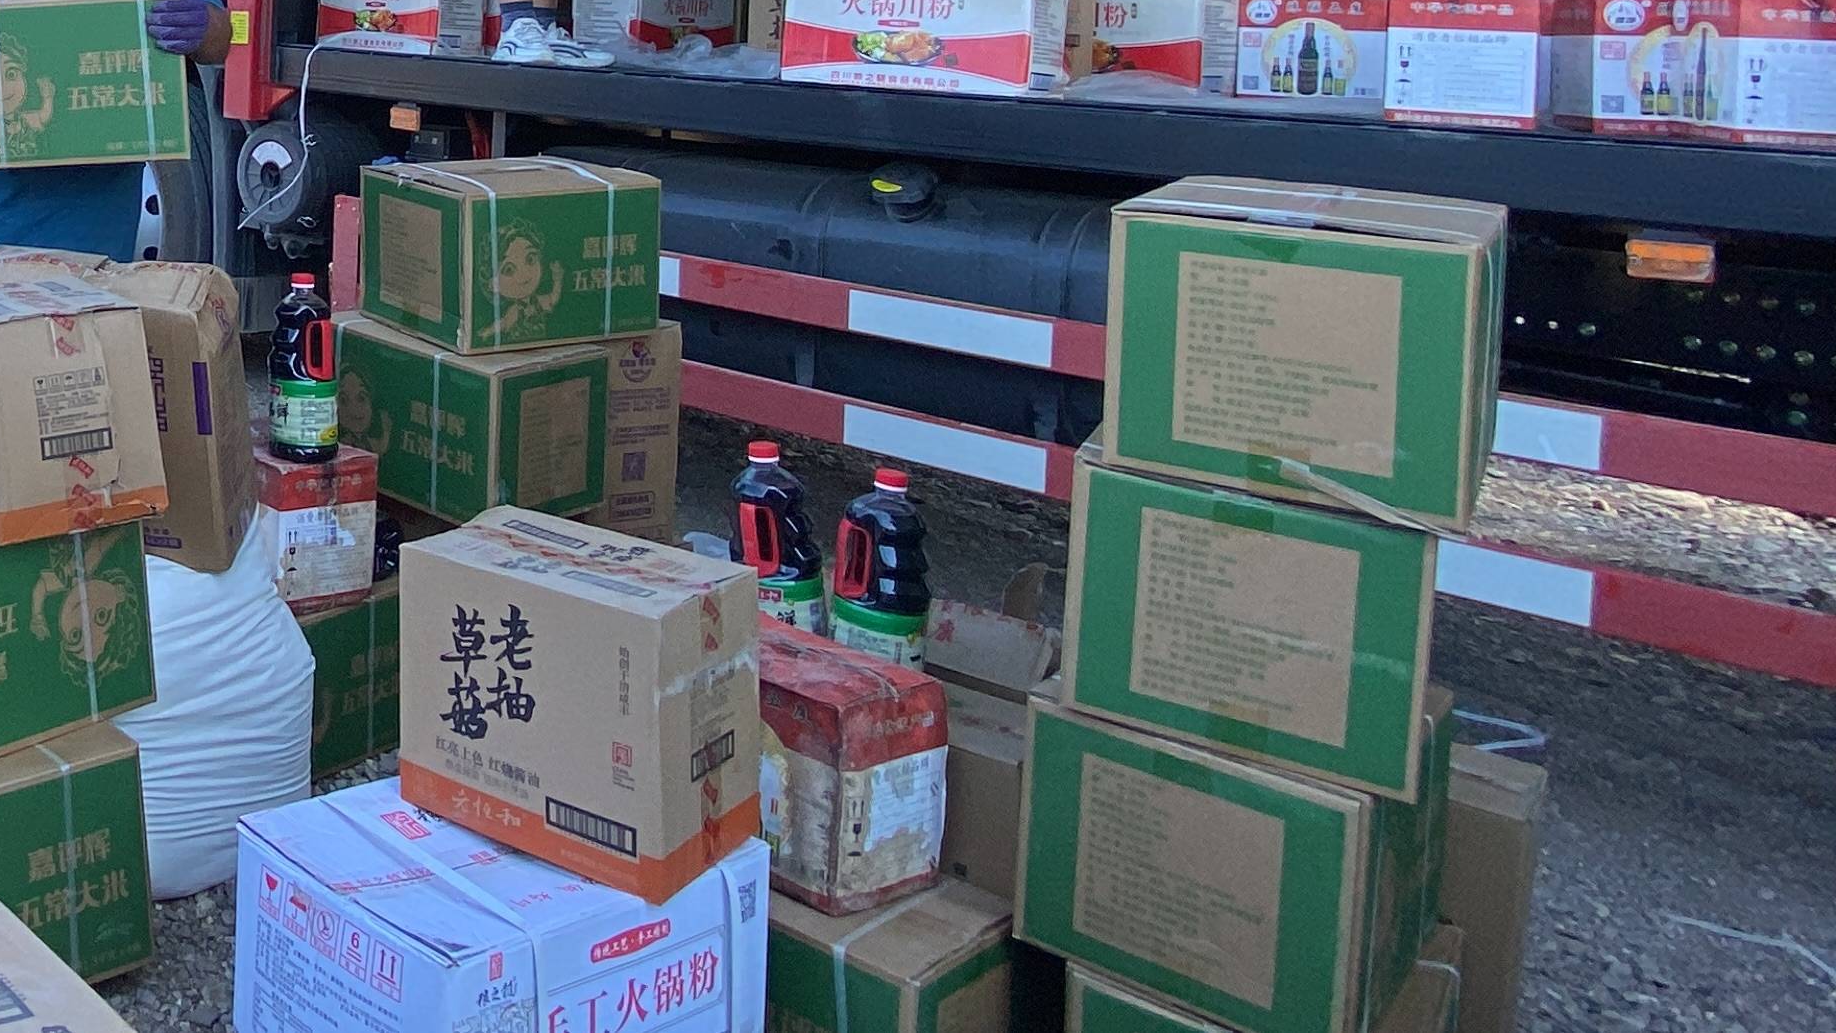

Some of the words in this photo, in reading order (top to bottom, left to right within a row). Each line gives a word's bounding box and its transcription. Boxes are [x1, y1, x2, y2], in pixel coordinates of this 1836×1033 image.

[67, 84, 166, 111] 五常大米
[440, 602, 489, 740] 草菇
[486, 602, 537, 726] 老抽
[16, 868, 130, 929] 五常大米
